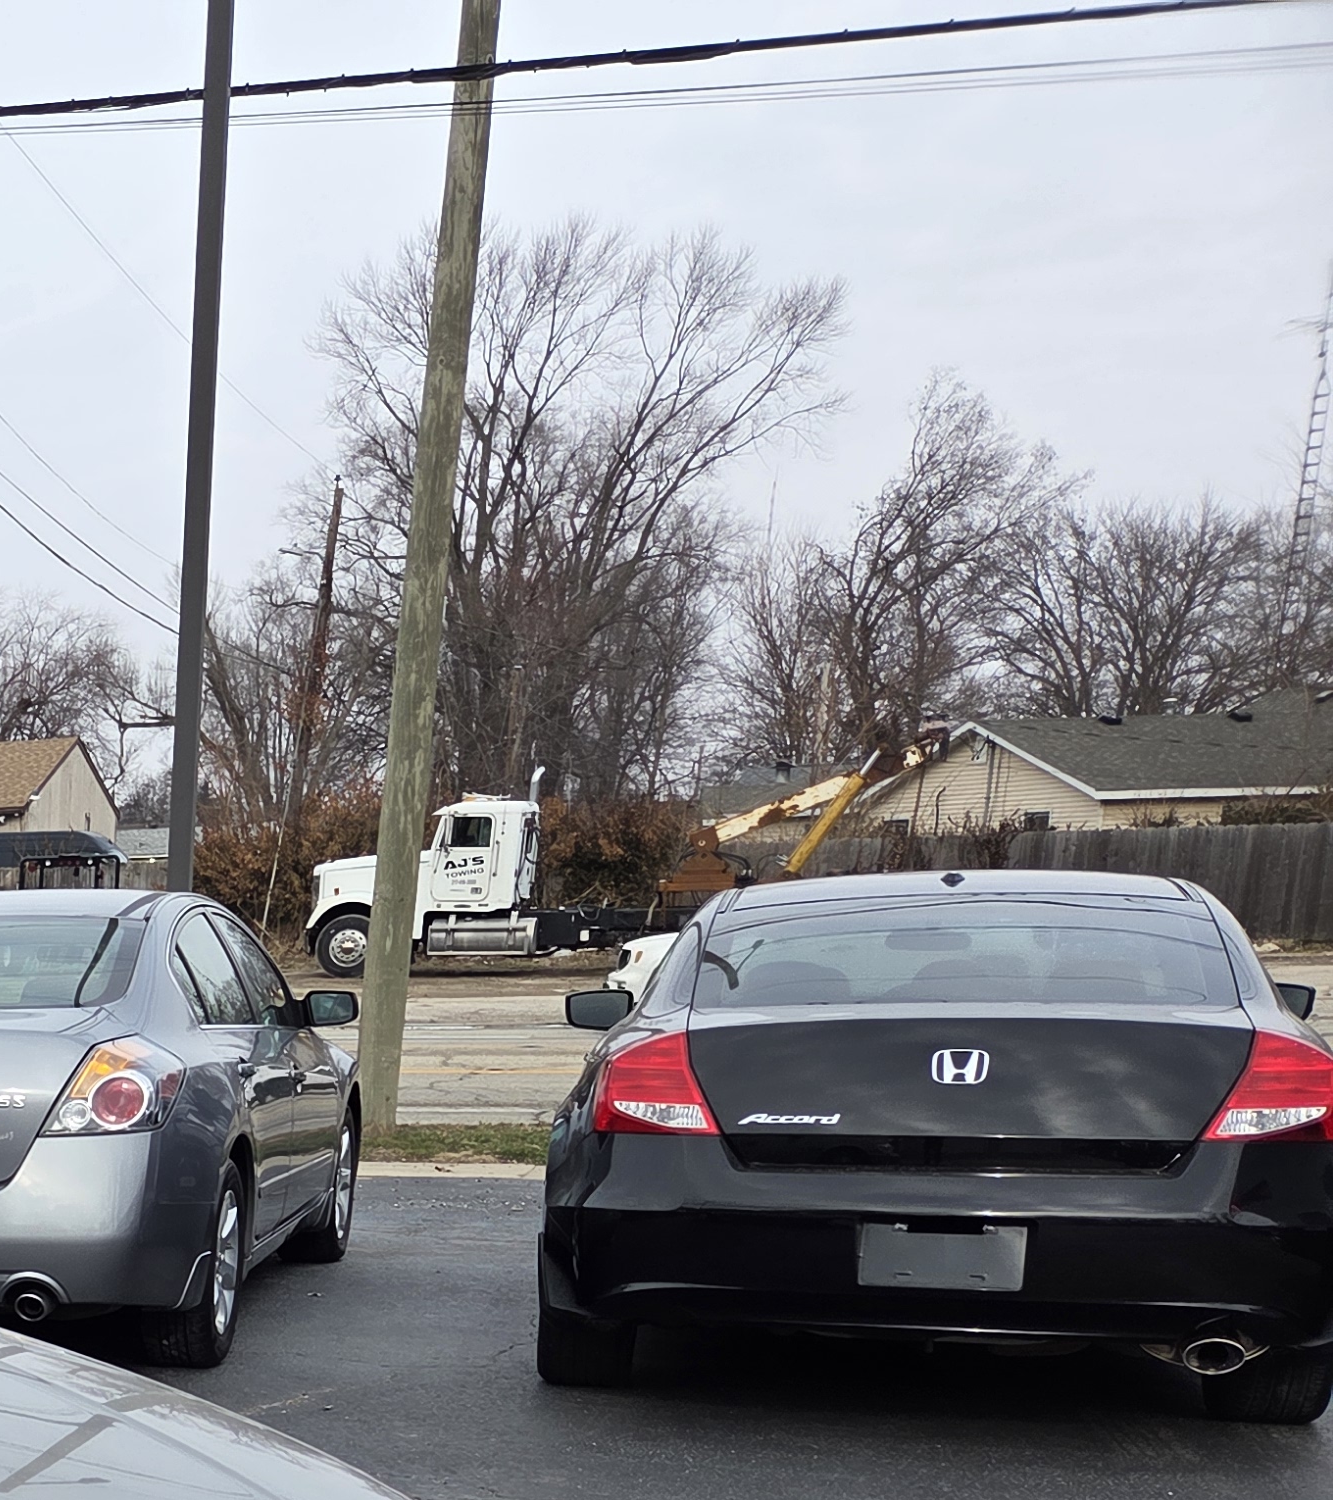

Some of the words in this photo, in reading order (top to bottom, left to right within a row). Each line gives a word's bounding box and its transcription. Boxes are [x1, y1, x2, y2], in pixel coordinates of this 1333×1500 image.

[444, 855, 485, 871] AJ'S
[445, 867, 485, 879] TOWING
[737, 1113, 841, 1126] Accord
